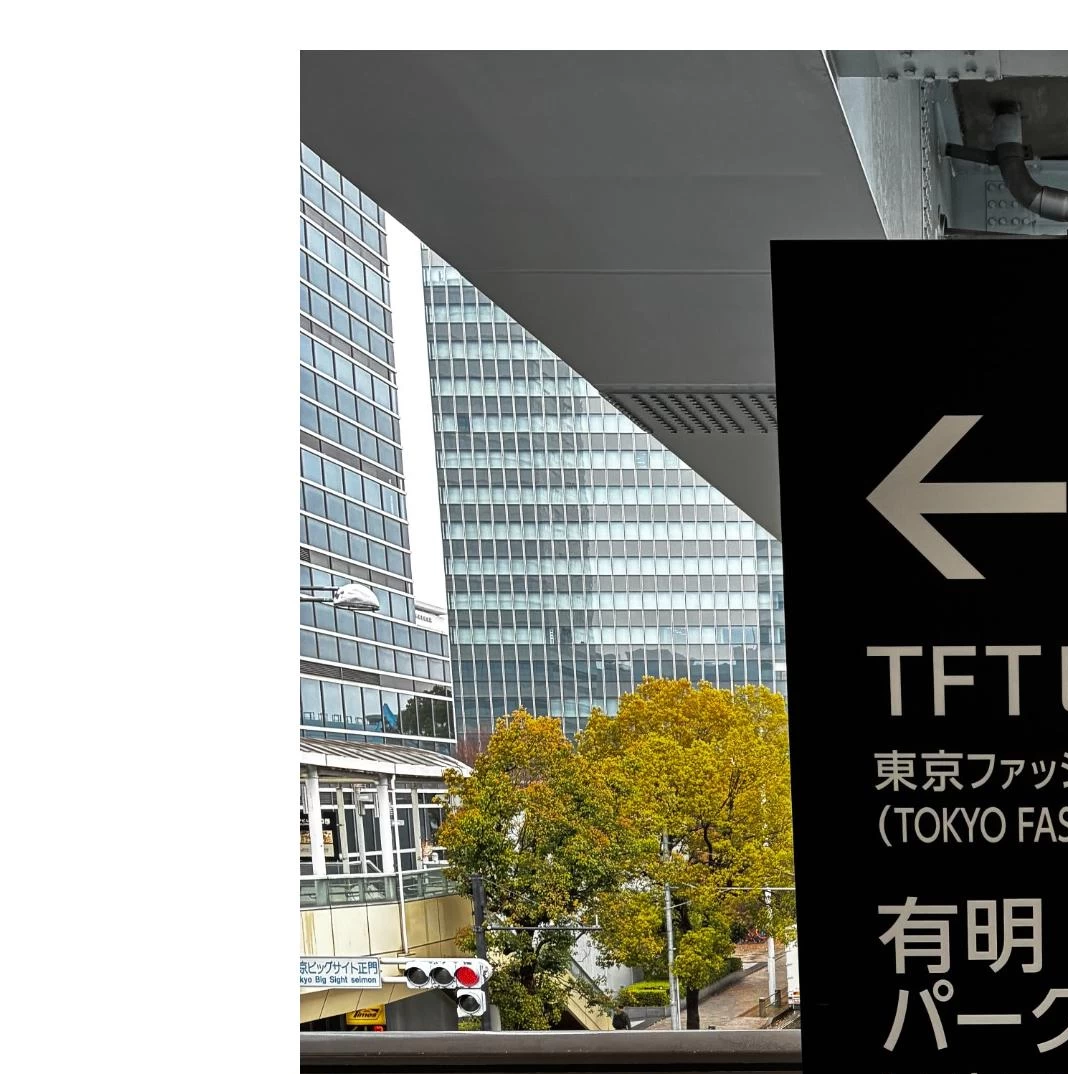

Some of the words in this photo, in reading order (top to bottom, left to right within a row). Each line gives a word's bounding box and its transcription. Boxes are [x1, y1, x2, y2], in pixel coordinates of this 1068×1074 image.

[878, 804, 1007, 847] (TOKYO
[877, 896, 1043, 974] 有明
[315, 975, 327, 984] Big
[329, 975, 348, 985] Sight
[351, 976, 377, 984] seimon
